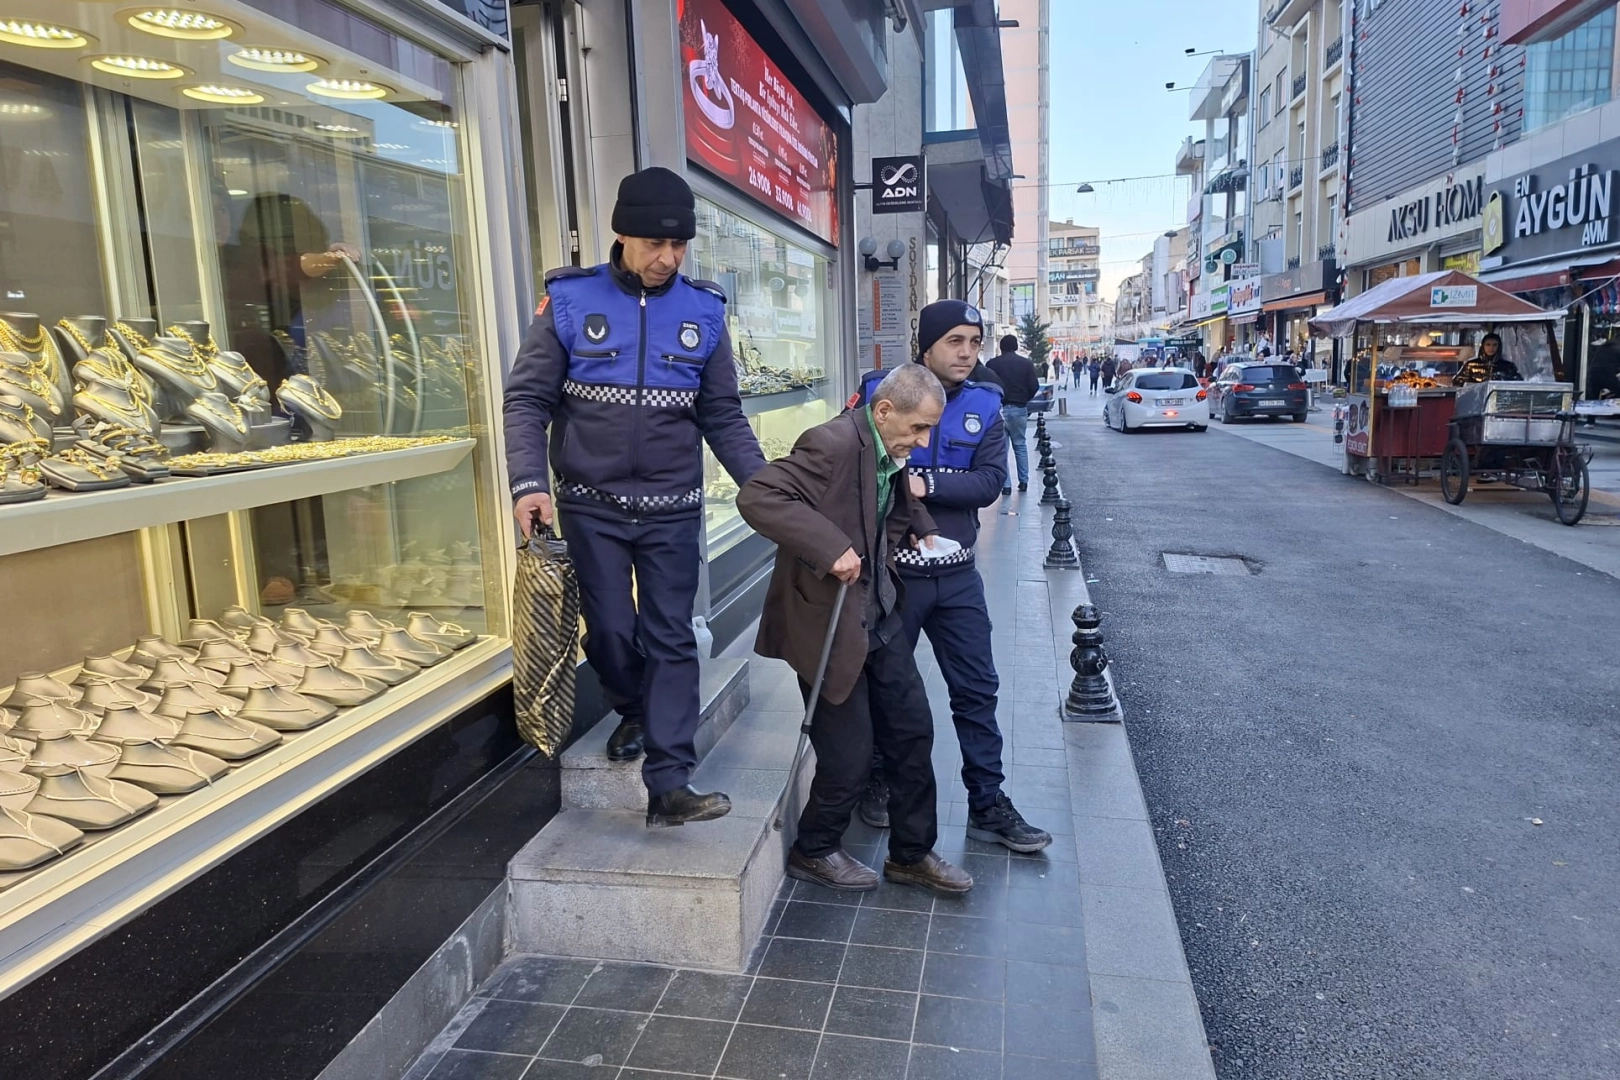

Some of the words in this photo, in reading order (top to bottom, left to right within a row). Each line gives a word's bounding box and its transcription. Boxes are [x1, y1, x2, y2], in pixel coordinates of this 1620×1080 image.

[881, 186, 917, 199] ADN
[1515, 175, 1530, 198] EN
[1387, 197, 1429, 242] AKSU
[1436, 175, 1483, 228] HOM
[1514, 163, 1612, 238] AYGÜN
[1581, 218, 1609, 245] AVM
[909, 237, 918, 311] SOYDAN
[511, 480, 539, 495] ZABITA
